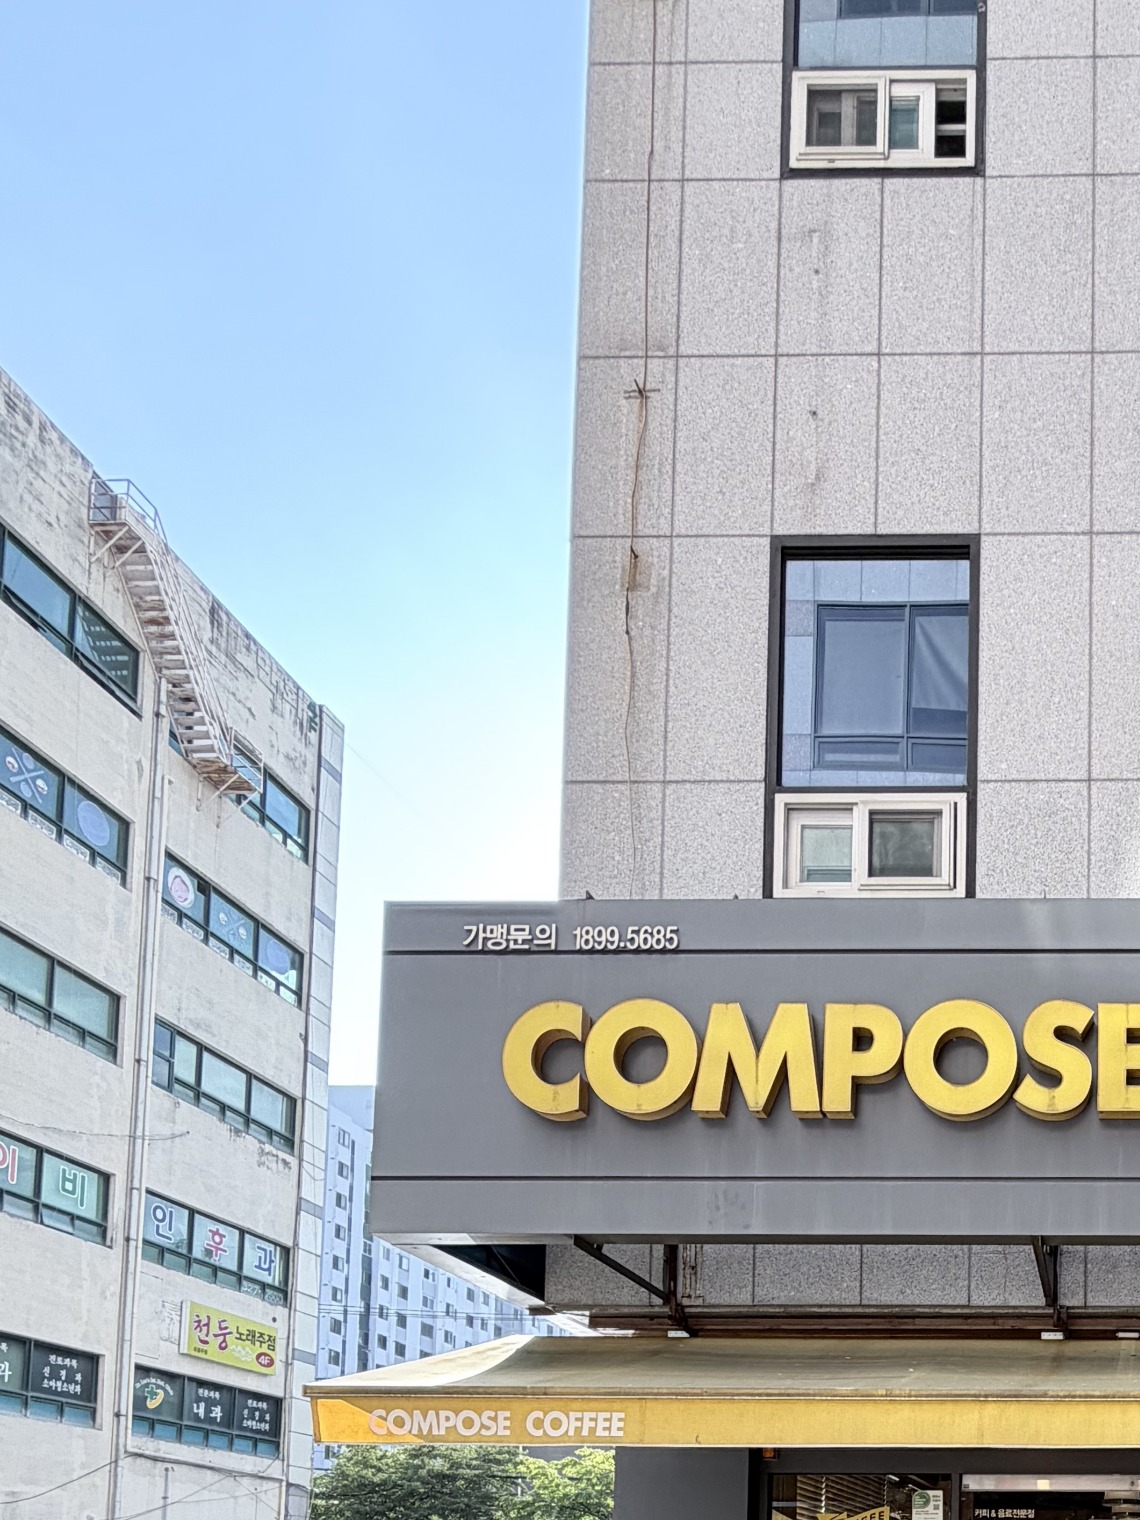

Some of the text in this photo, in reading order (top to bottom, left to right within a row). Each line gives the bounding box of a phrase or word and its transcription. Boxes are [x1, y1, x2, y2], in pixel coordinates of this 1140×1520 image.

[463, 923, 680, 951] 가맹문의 1899.5685
[193, 1313, 277, 1352] 천둥 노래주점
[258, 1355, 272, 1366] 4F
[192, 1402, 222, 1422] 내과
[368, 1408, 626, 1438] COMPOSE COFFEE
[974, 1508, 989, 1519] 커피
